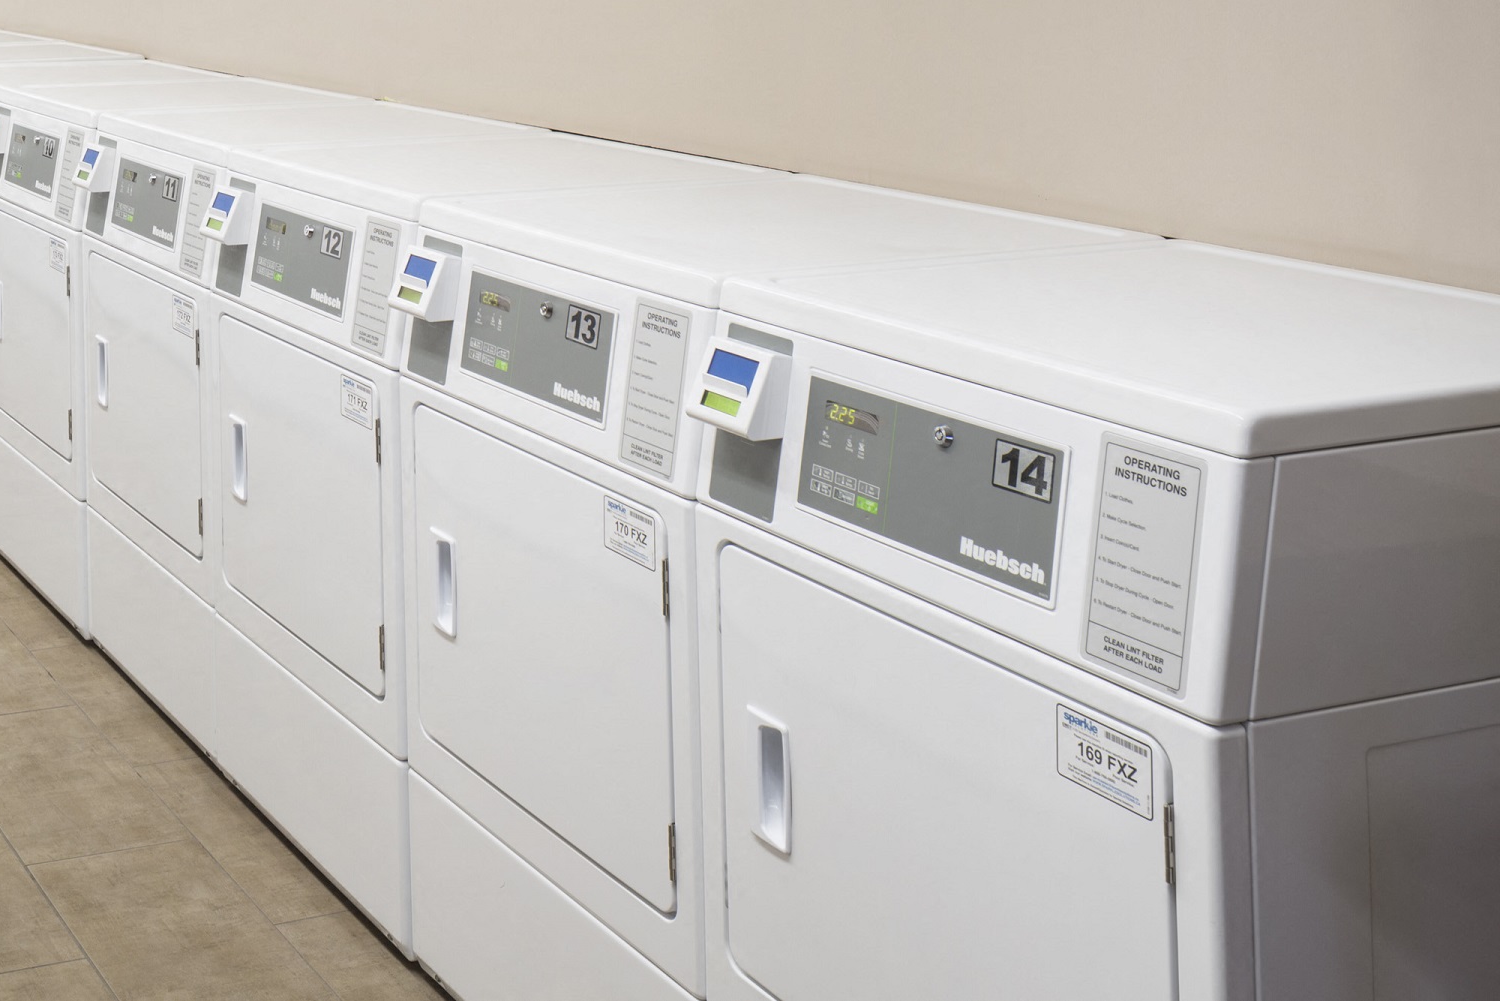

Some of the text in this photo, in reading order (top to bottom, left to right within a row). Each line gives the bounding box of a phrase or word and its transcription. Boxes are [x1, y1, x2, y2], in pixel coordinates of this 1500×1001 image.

[165, 177, 177, 199] 11
[324, 229, 342, 257] 12
[310, 287, 341, 310] Huebsch
[571, 310, 597, 344] 13
[642, 321, 681, 339] INSTRUCTIONS
[647, 312, 678, 328] OPERATING
[553, 381, 601, 412] Huebsch
[829, 403, 856, 425] 2.25
[1001, 447, 1048, 496] 14
[1114, 466, 1188, 497] INSTRUCTIONS
[1123, 455, 1181, 480] OPERATING
[615, 520, 648, 546] 170 FXZ
[959, 535, 1046, 585] Huebsch
[1103, 635, 1165, 665] CLEAN LINT FILTER
[1103, 645, 1163, 674] AFTER EACH LOAD
[1063, 711, 1099, 734] sparkle
[1077, 741, 1103, 765] 169
[1107, 754, 1138, 784] FXZ
